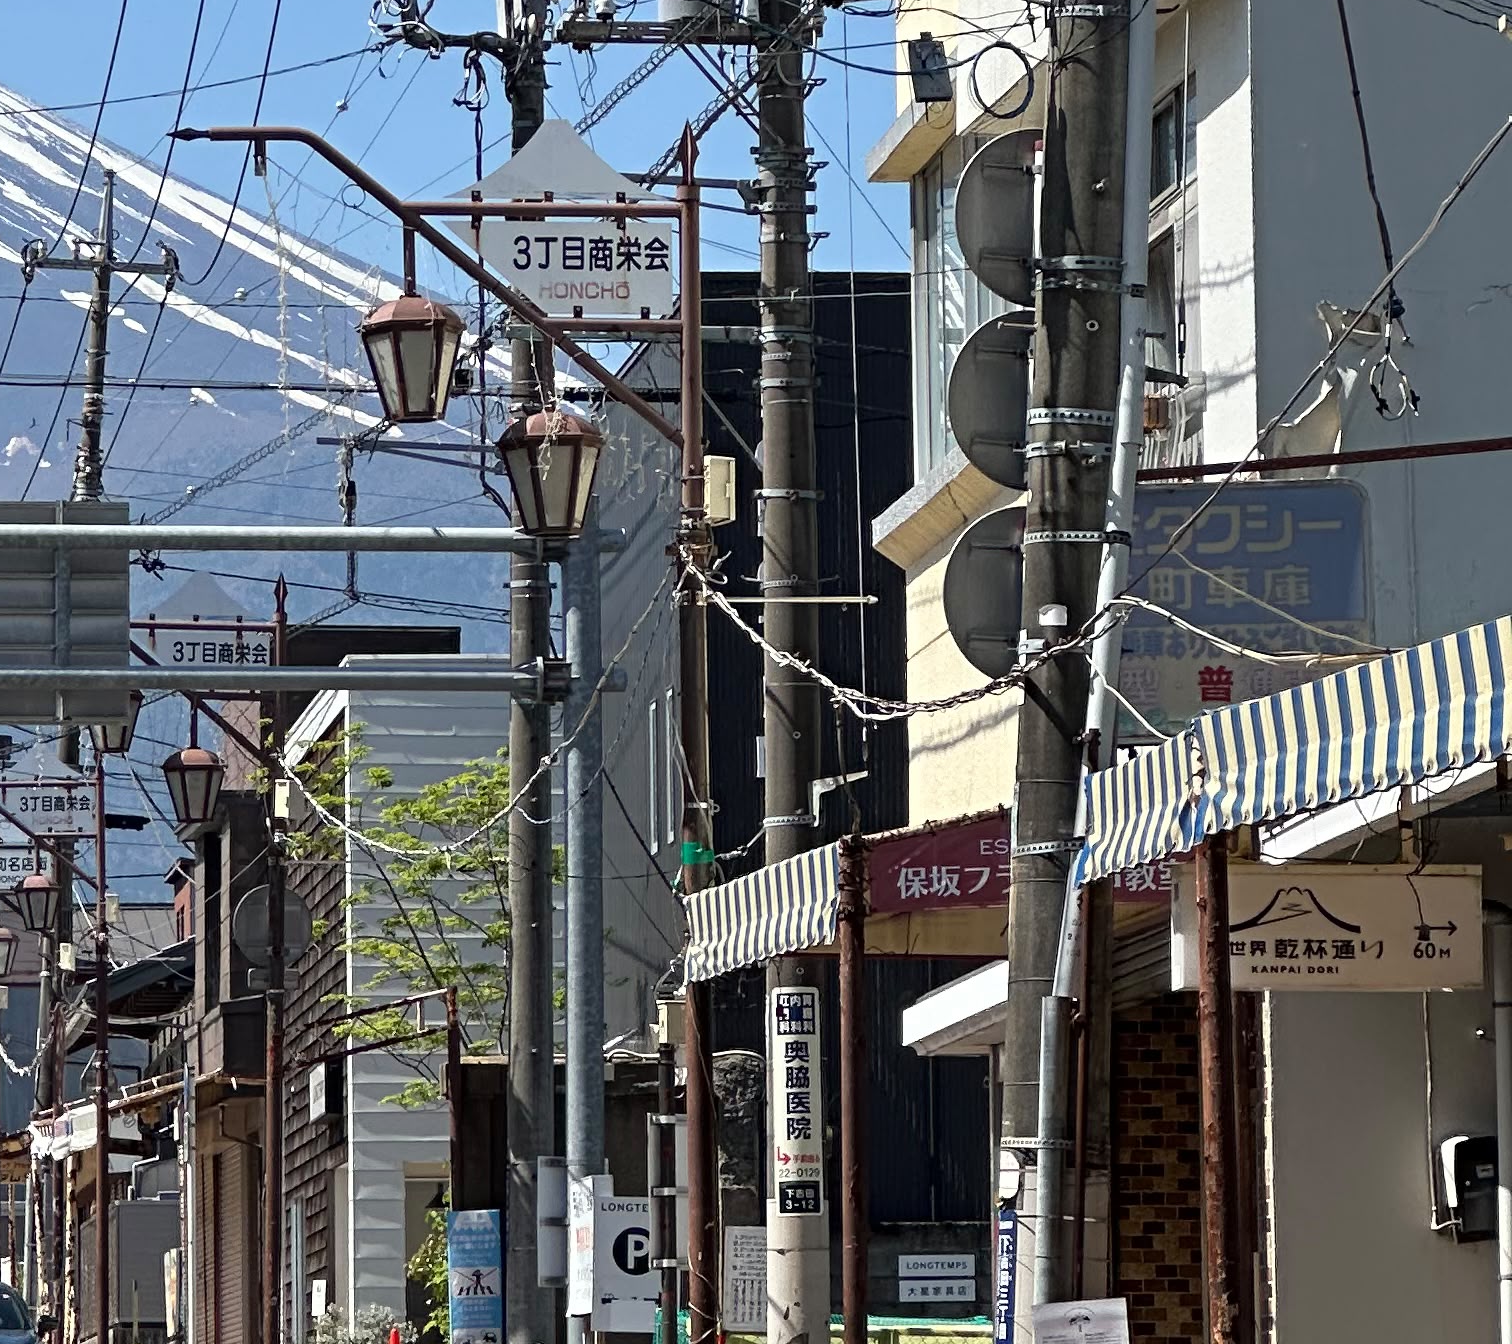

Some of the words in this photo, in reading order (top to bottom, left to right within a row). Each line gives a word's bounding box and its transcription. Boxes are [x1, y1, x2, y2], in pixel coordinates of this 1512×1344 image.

[513, 235, 669, 272] 3丁目商栄会
[1133, 504, 1342, 554] タクシー
[172, 641, 268, 664] 3丁目商栄会
[20, 795, 91, 812] 3丁目商栄会
[1274, 938, 1384, 959] 乾杯通り
[1251, 965, 1301, 974] KANPAI
[1307, 965, 1339, 974] DORI
[784, 1039, 811, 1141] 奥脇医院
[785, 1199, 815, 1210] 3-12
[906, 1261, 968, 1270] LONGTEMPS
